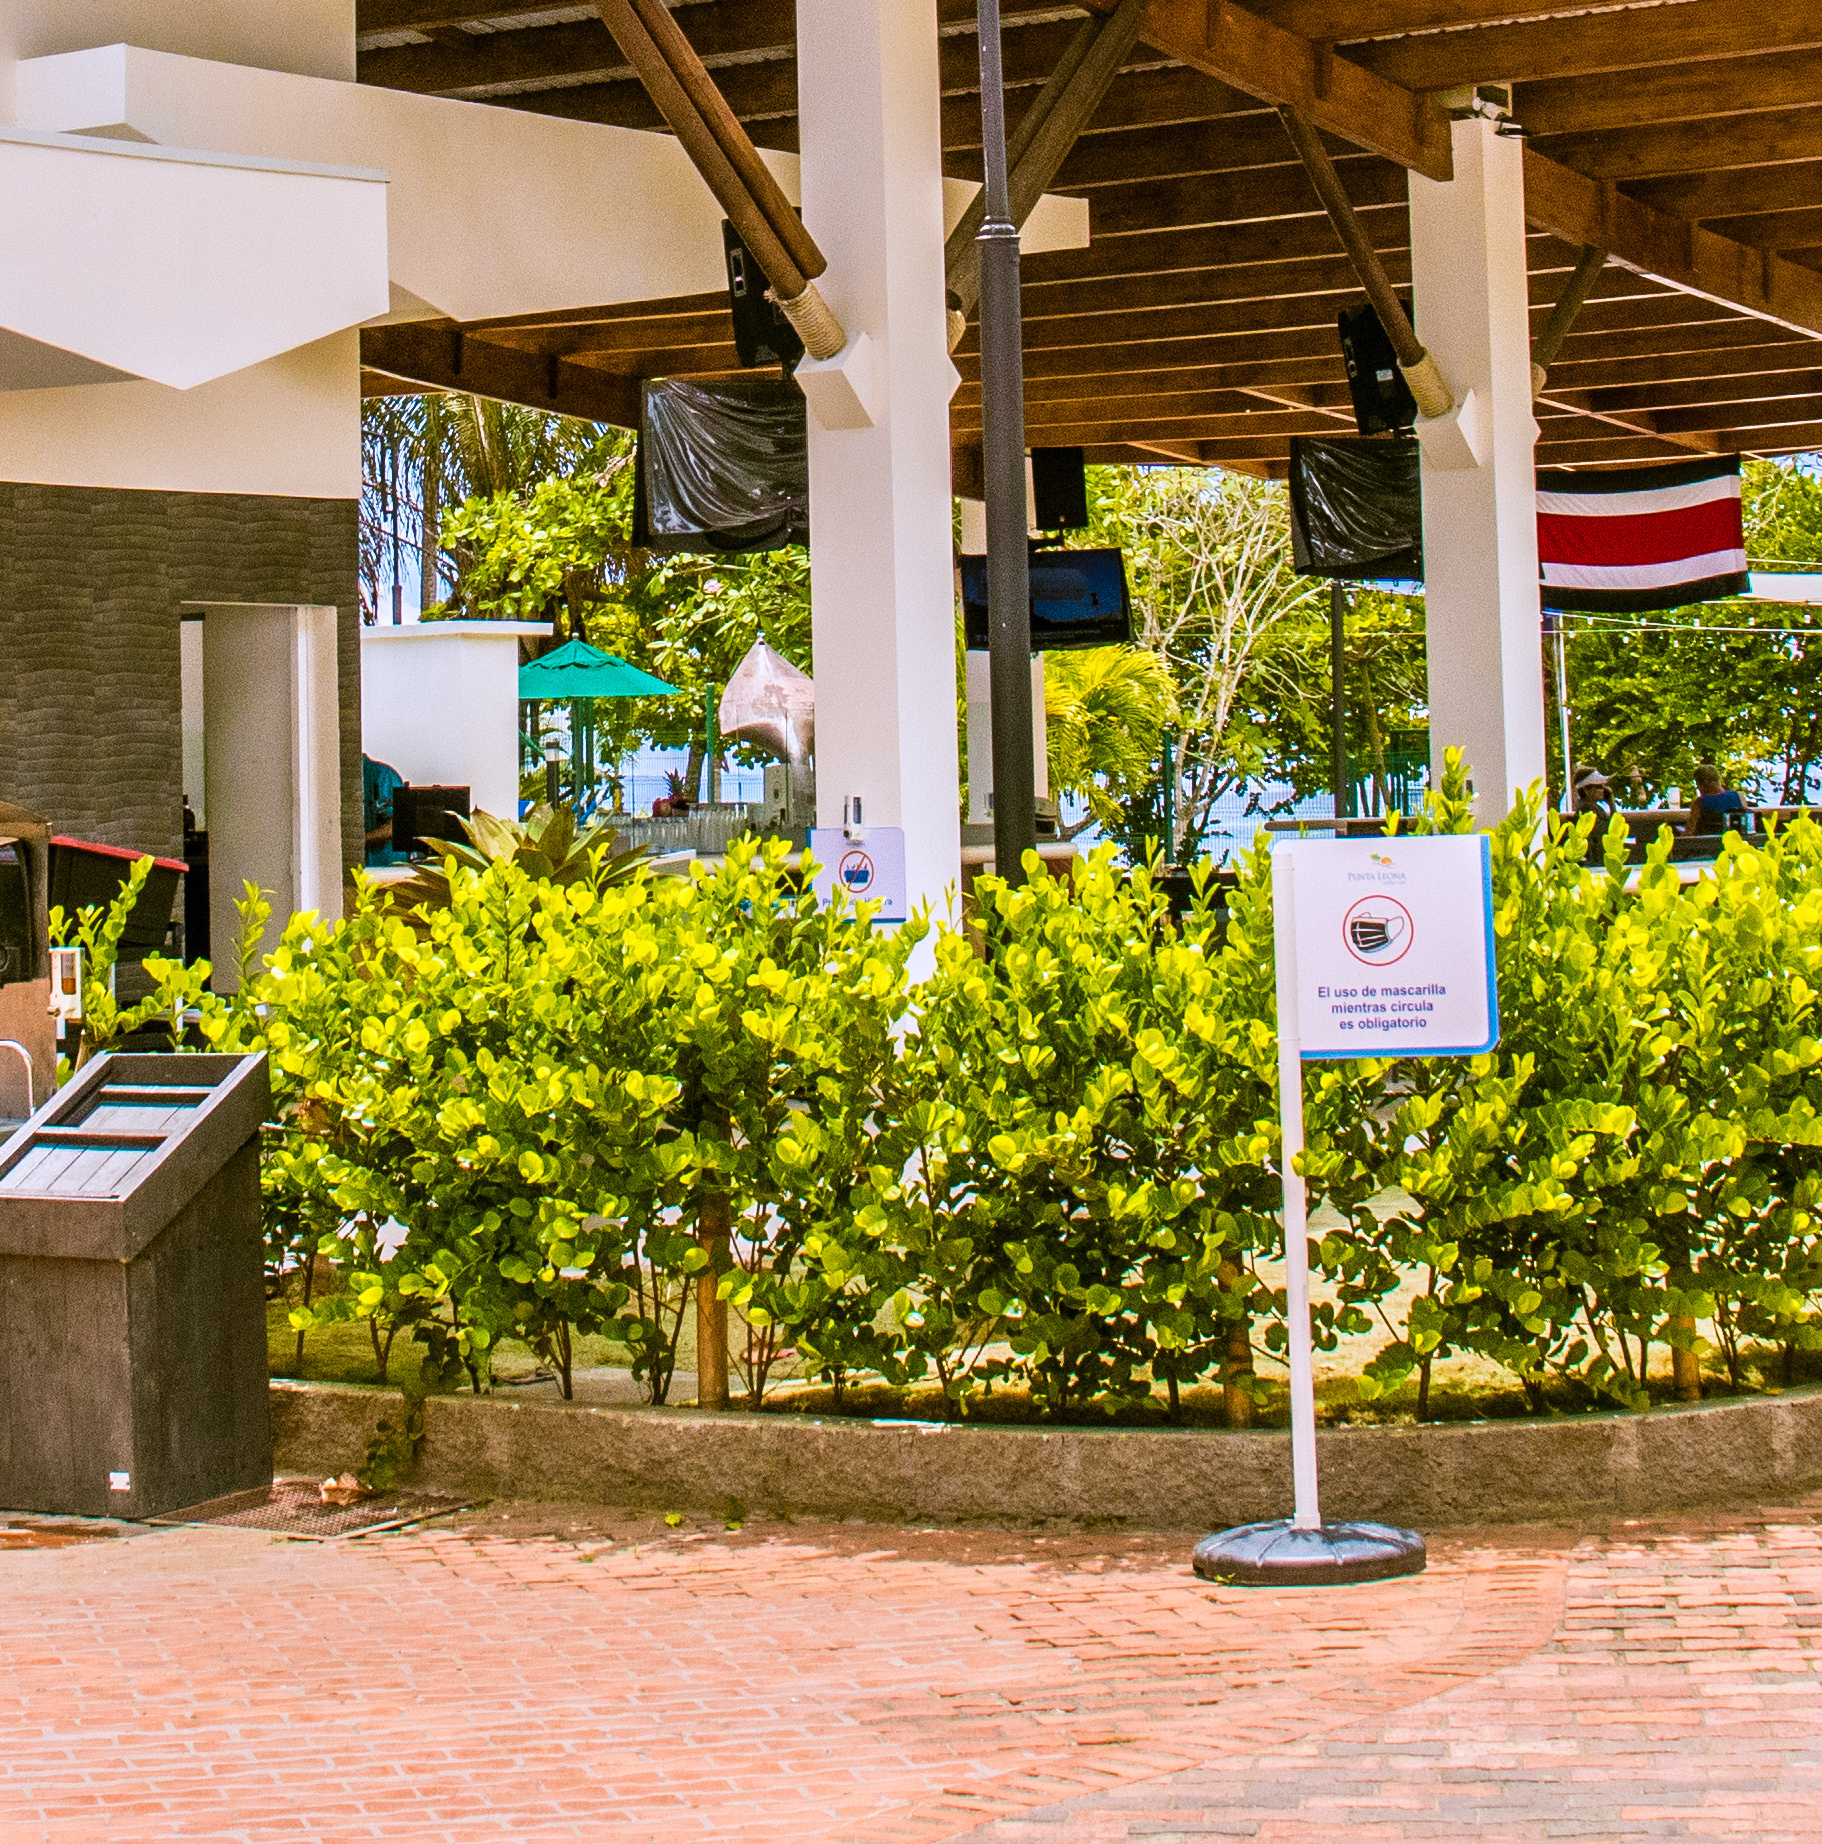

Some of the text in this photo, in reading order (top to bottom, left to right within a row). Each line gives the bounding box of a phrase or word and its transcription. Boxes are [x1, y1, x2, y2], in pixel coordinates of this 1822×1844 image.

[1348, 872, 1376, 882] PUNTA
[1317, 983, 1447, 998] El uso de mascarilla
[1331, 1000, 1434, 1014] mientras circula
[1339, 1016, 1427, 1032] es obligatorio
